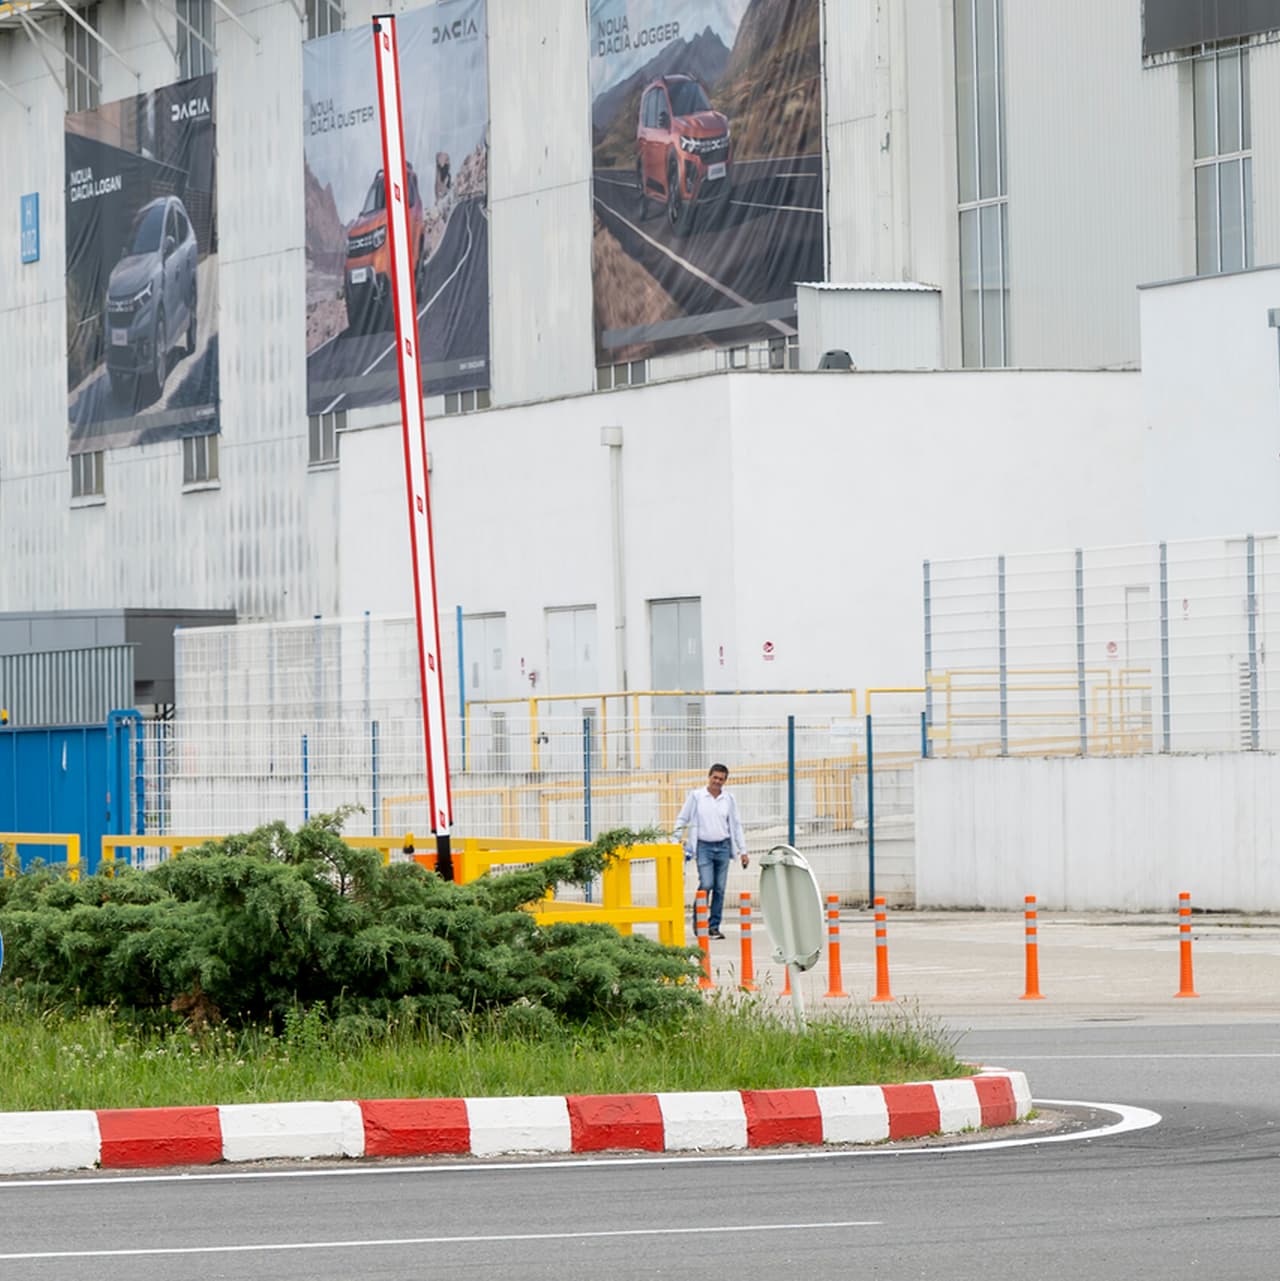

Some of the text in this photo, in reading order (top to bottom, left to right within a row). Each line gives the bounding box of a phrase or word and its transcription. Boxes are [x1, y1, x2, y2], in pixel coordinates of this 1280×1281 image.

[432, 18, 478, 45] DACIA
[598, 21, 681, 57] DACIA JOGGER
[171, 97, 210, 122] DACIA
[311, 105, 375, 136] DACIA DUSTER
[71, 175, 122, 203] DACIA LOGAN
